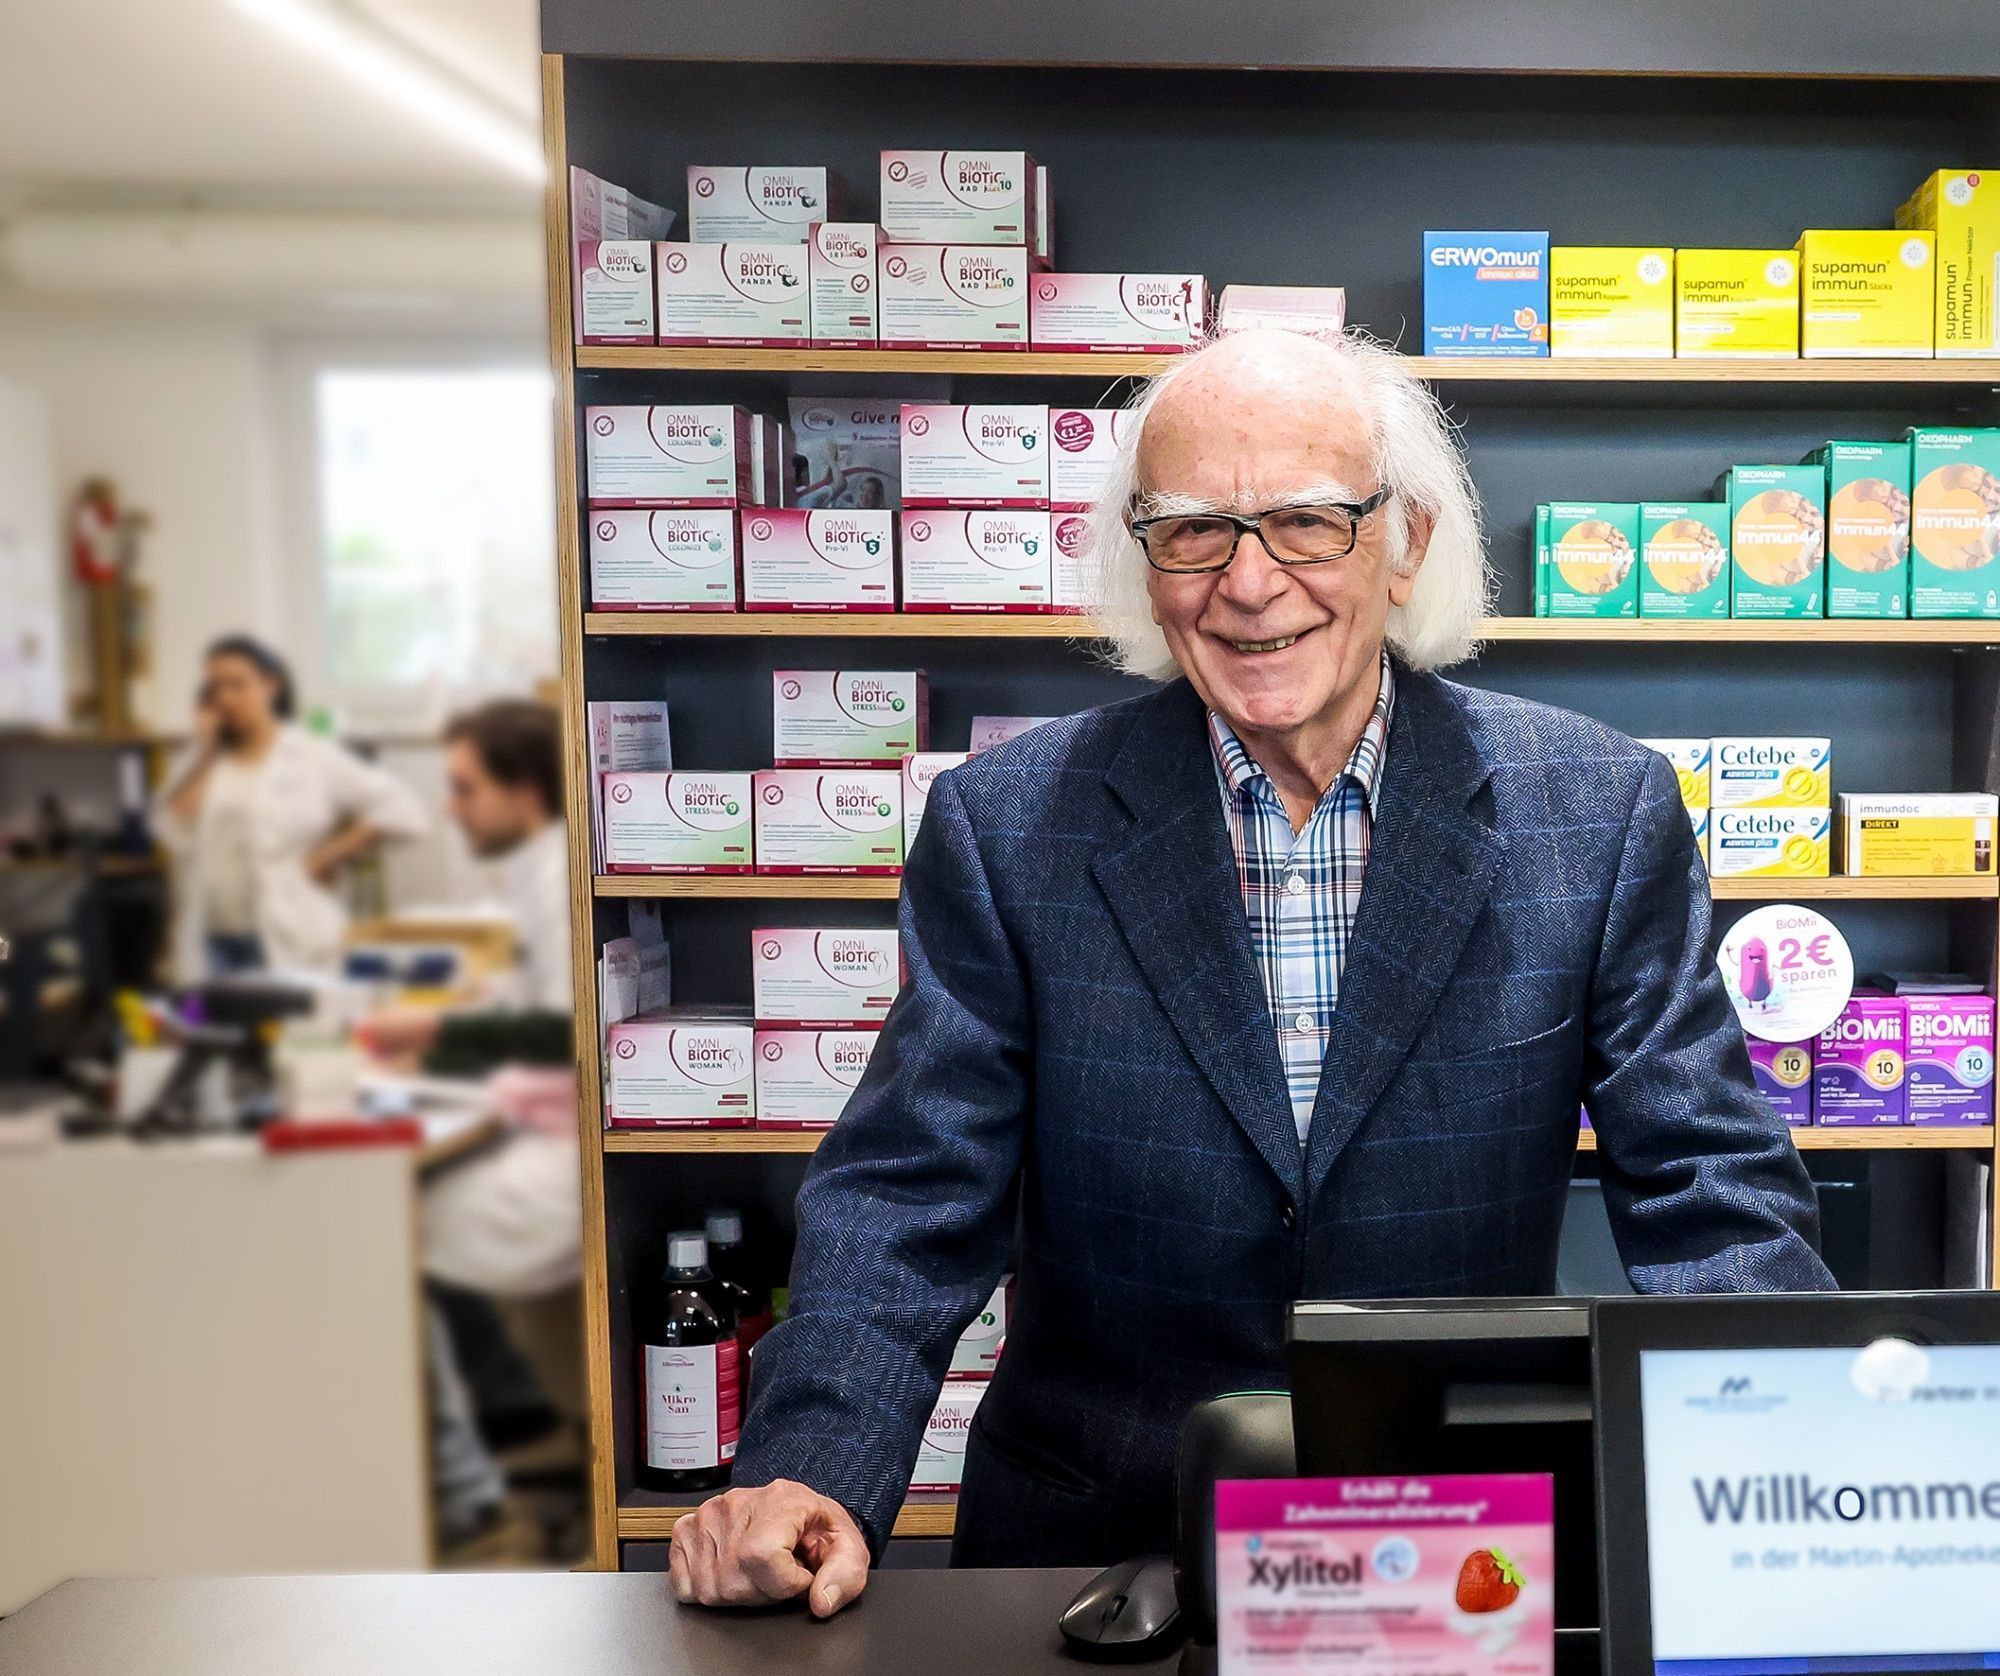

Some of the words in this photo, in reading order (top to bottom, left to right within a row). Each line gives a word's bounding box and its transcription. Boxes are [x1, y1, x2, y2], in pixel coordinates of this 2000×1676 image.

[1000, 180, 1012, 190] 10
[1430, 247, 1541, 267] ERWOmun
[1811, 262, 1886, 277] supamun
[741, 278, 773, 286] PANDA
[1001, 277, 1014, 288] 10
[1555, 276, 1617, 290] supamun
[1683, 279, 1745, 292] supamun
[1811, 276, 1868, 290] immun
[1555, 289, 1602, 300] immun
[1683, 291, 1730, 303] immun
[1945, 264, 1959, 340] supamun
[1959, 283, 1973, 340] immun
[851, 411, 886, 425] Give
[852, 703, 877, 711] STRESS
[1720, 745, 1796, 765] Cetebe
[1755, 770, 1775, 780] plus
[684, 807, 711, 815] STRESS
[836, 808, 862, 816] STRESS
[1860, 803, 1920, 814] immundoc
[1719, 814, 1796, 834] Cetebe
[1755, 839, 1775, 849] plus
[1776, 917, 1818, 930] BiOMii
[833, 964, 868, 972] WOMAN
[1781, 968, 1837, 984] sparen
[1820, 1018, 1901, 1041] BiOMii
[1910, 1014, 1990, 1037] BiOMii
[834, 1052, 868, 1064] BiOTi
[1966, 1058, 1983, 1071] 10
[1783, 1058, 1801, 1072] 10
[1876, 1062, 1894, 1074] 10
[662, 1395, 697, 1404] Mikro
[1341, 1482, 1396, 1500] Erhält
[1402, 1481, 1431, 1499] die
[1732, 1549, 1755, 1569] in
[1761, 1547, 1799, 1569] der
[1247, 1553, 1363, 1594] Xylitol
